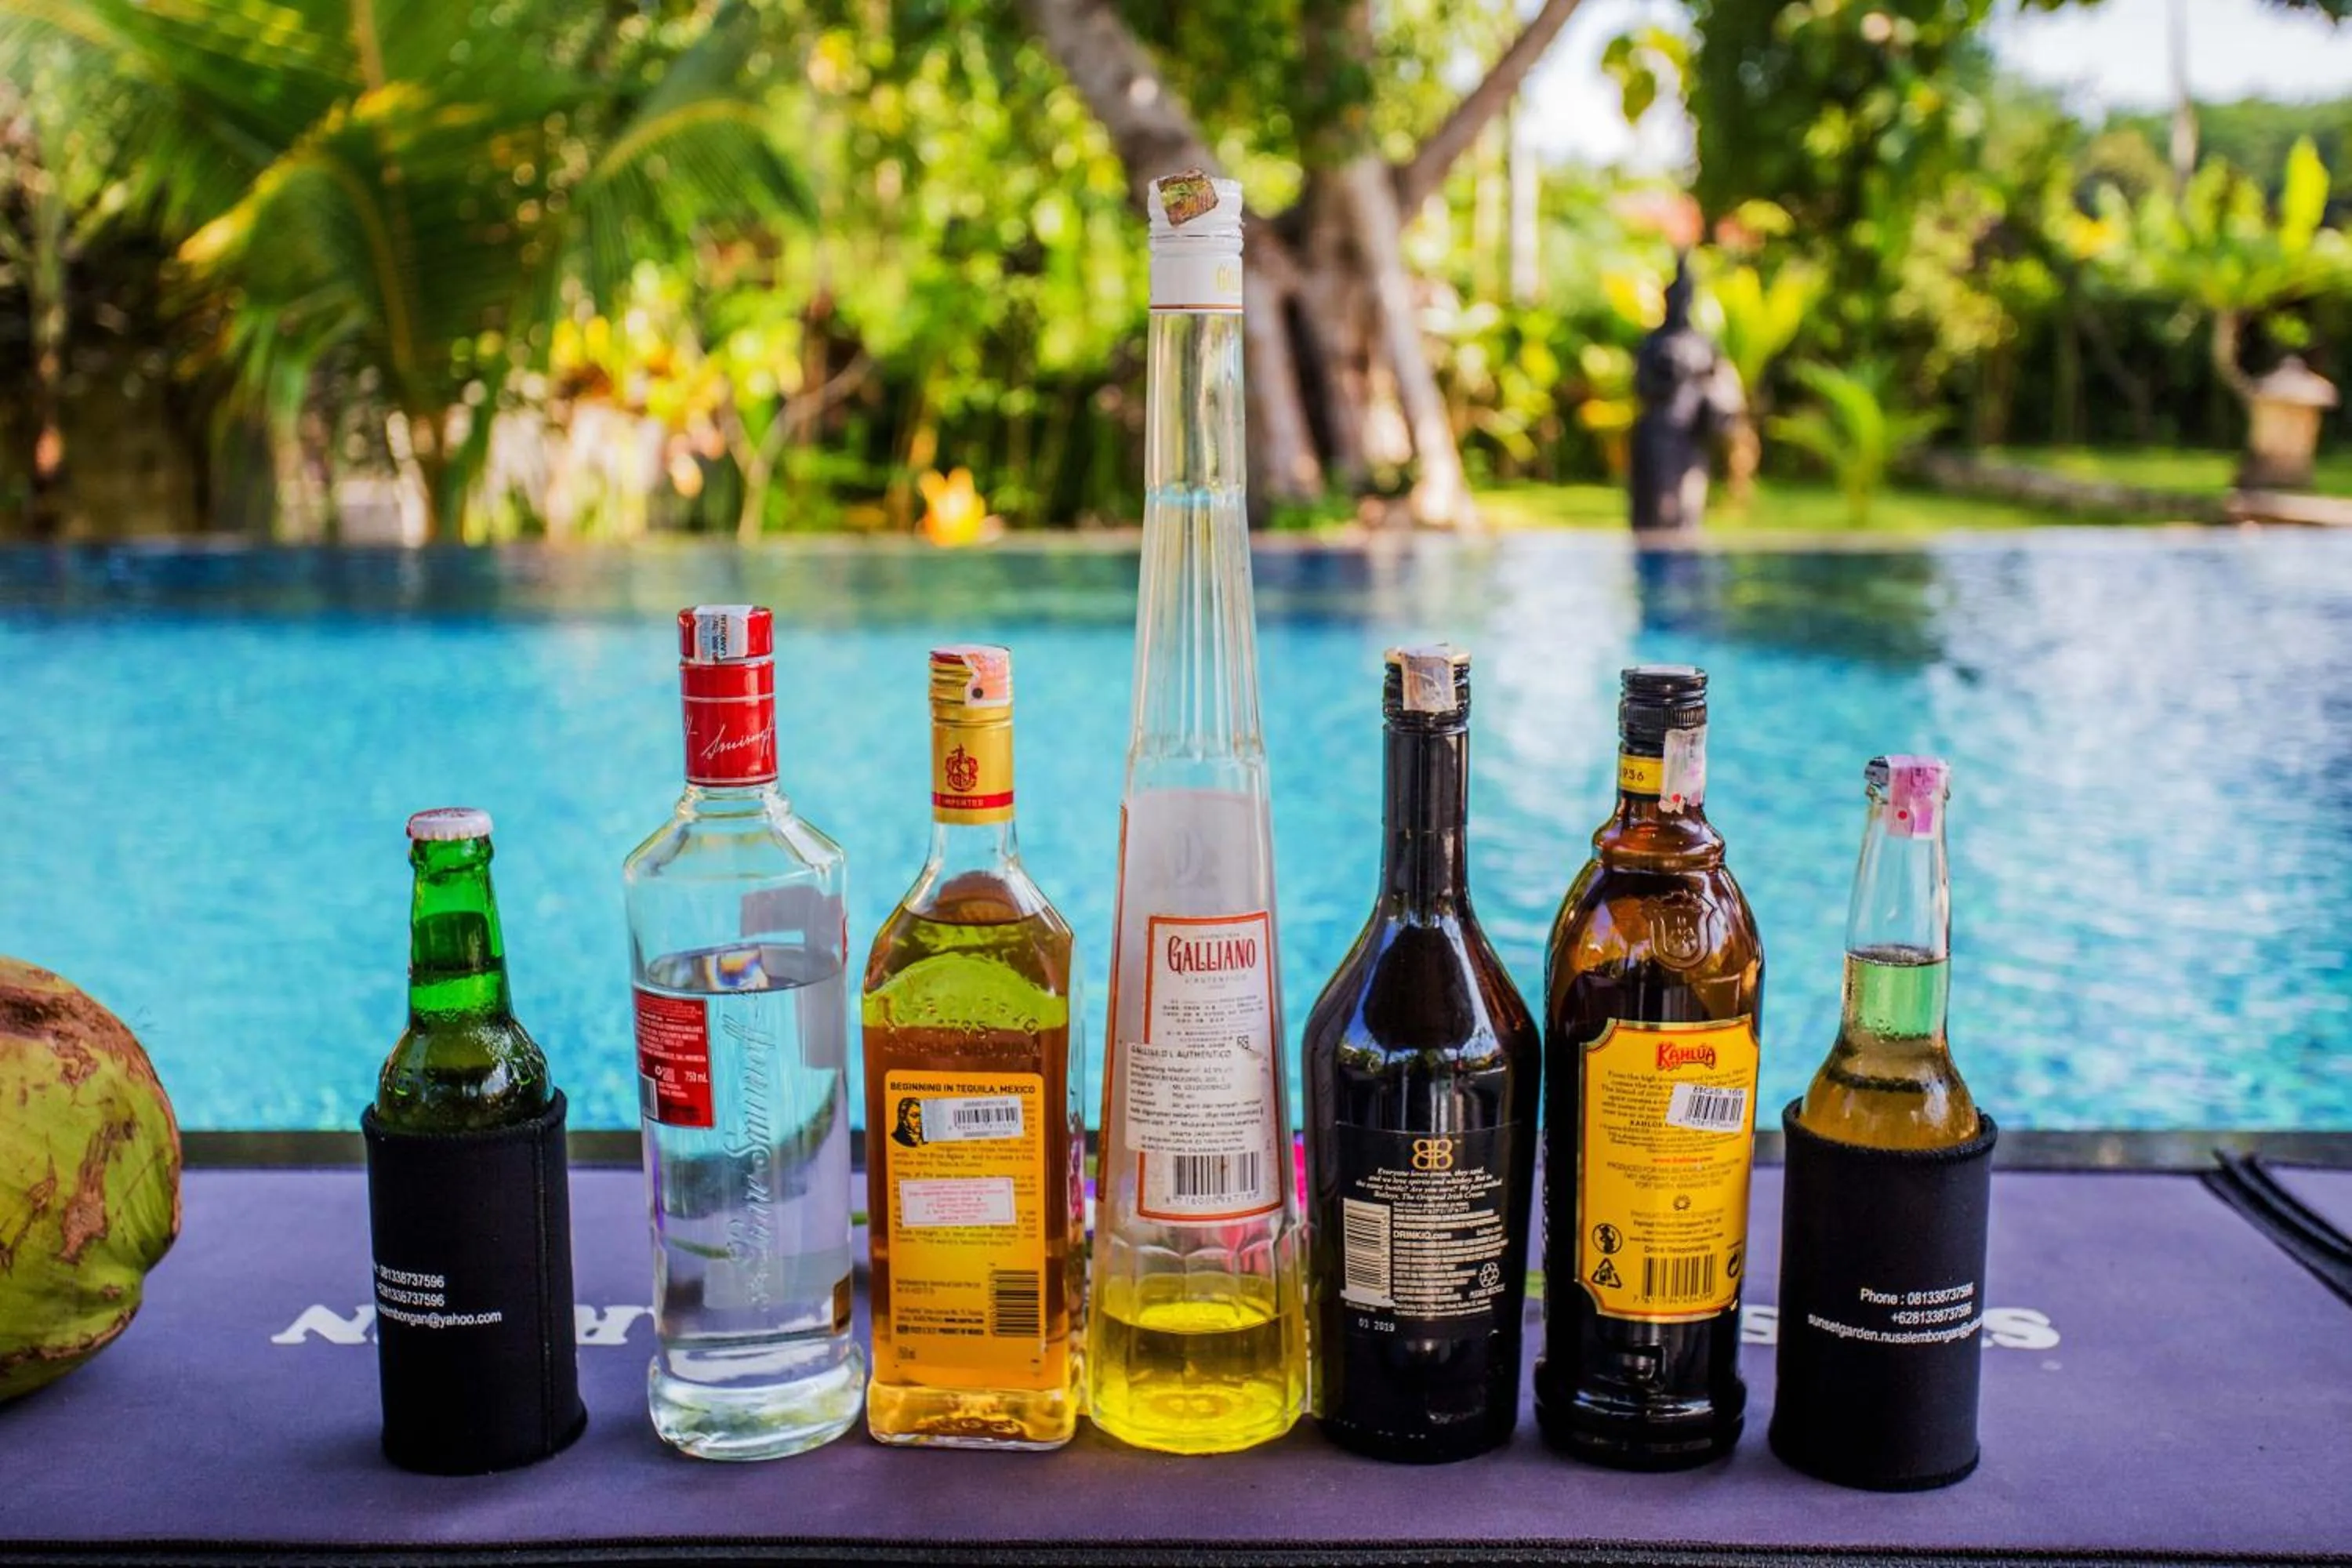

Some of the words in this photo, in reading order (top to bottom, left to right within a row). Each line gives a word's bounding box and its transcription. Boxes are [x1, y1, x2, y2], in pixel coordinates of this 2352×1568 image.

[1167, 935, 1255, 975] GALLIANO
[891, 1082, 942, 1091] BEGINNING
[956, 1085, 997, 1094] TEQUILA,
[1860, 1287, 1898, 1305] Phone
[1907, 1282, 1974, 1305] 081338737596
